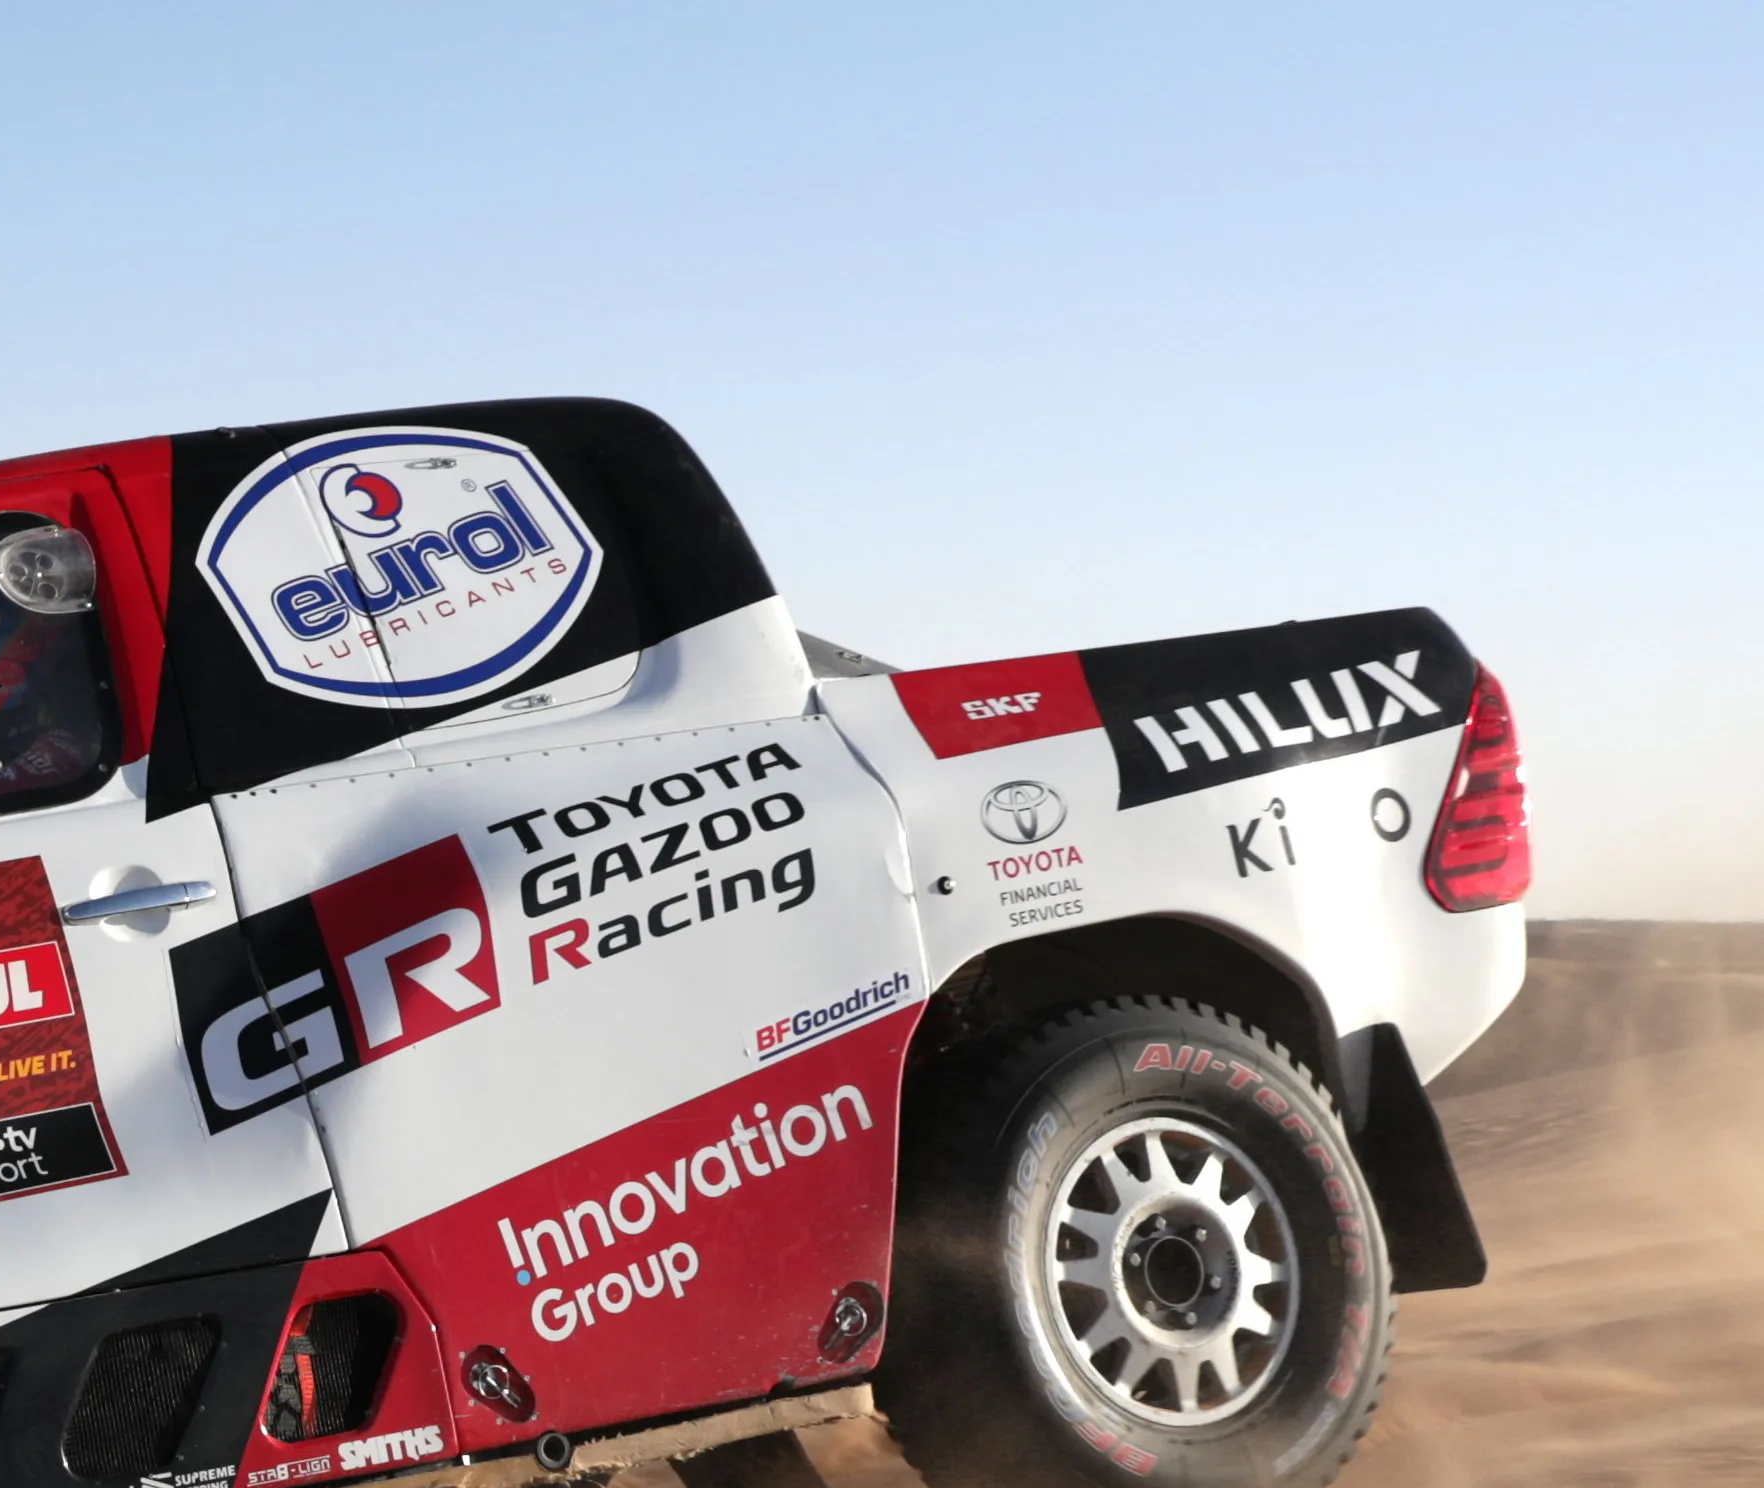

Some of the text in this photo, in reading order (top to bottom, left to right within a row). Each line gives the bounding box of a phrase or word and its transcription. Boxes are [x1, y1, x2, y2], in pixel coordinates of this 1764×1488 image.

[271, 481, 553, 641] eurol
[304, 558, 567, 669] LUBRICANTS
[960, 691, 1042, 720] SKF
[1134, 650, 1441, 773] HILUX
[487, 743, 802, 854] TOYOTA
[519, 791, 805, 919] GAZOO
[987, 846, 1083, 881] TOYOTA
[1000, 878, 1083, 905] FINANCIAL
[528, 848, 815, 984] Racing
[1009, 900, 1084, 927] SERVICES
[201, 907, 491, 1111] GR
[756, 971, 909, 1052] BFGoodrich
[51, 1050, 76, 1072] IT.
[497, 1084, 873, 1285] Innovation
[532, 1242, 700, 1342] Group
[175, 1465, 236, 1487] SUPREME
[338, 1425, 443, 1471] SMITHS
